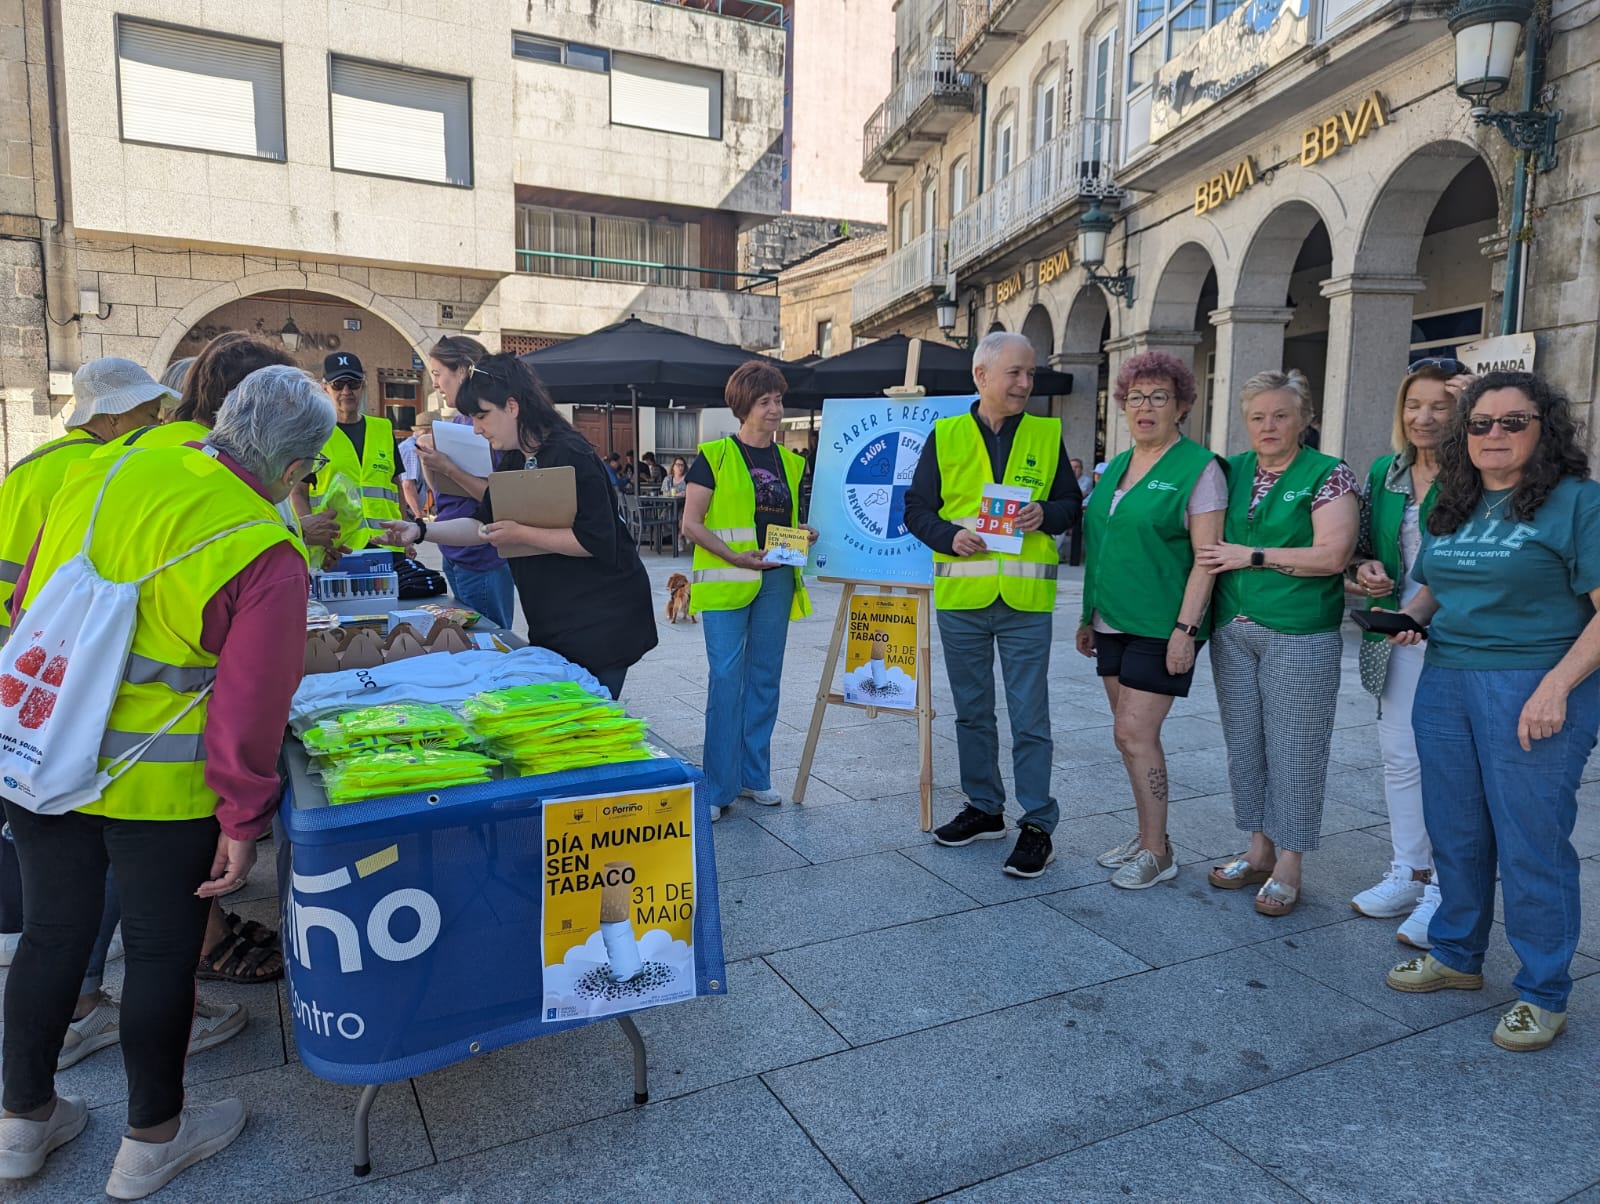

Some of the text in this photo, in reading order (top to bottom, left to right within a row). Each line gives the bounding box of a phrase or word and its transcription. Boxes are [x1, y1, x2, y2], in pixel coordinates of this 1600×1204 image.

[1302, 91, 1386, 167] BBVA
[1194, 154, 1256, 216] BBVA
[1039, 247, 1070, 285] BBVA
[997, 271, 1021, 304] BBVA
[1477, 358, 1525, 374] MANDA
[833, 413, 878, 454] SABER
[886, 407, 893, 422] E
[902, 405, 948, 426] RESP
[860, 439, 887, 466] SAÚDE
[901, 436, 922, 456] ESTA
[846, 487, 884, 537] PREVENCIÓN
[1476, 550, 1511, 558] FOREVER
[850, 621, 870, 631] SEN
[851, 610, 916, 625] DÍA MUNDIAL
[850, 631, 890, 643] TABACO
[886, 644, 916, 656] 31 DE
[887, 655, 916, 666] MAIO
[602, 804, 643, 816] O Porriño
[546, 821, 691, 857] DÍA MUNDIAL
[547, 854, 589, 877] SEN
[547, 867, 636, 897] TABACO
[632, 883, 692, 905] 31 DE
[637, 903, 693, 925] MAIO
